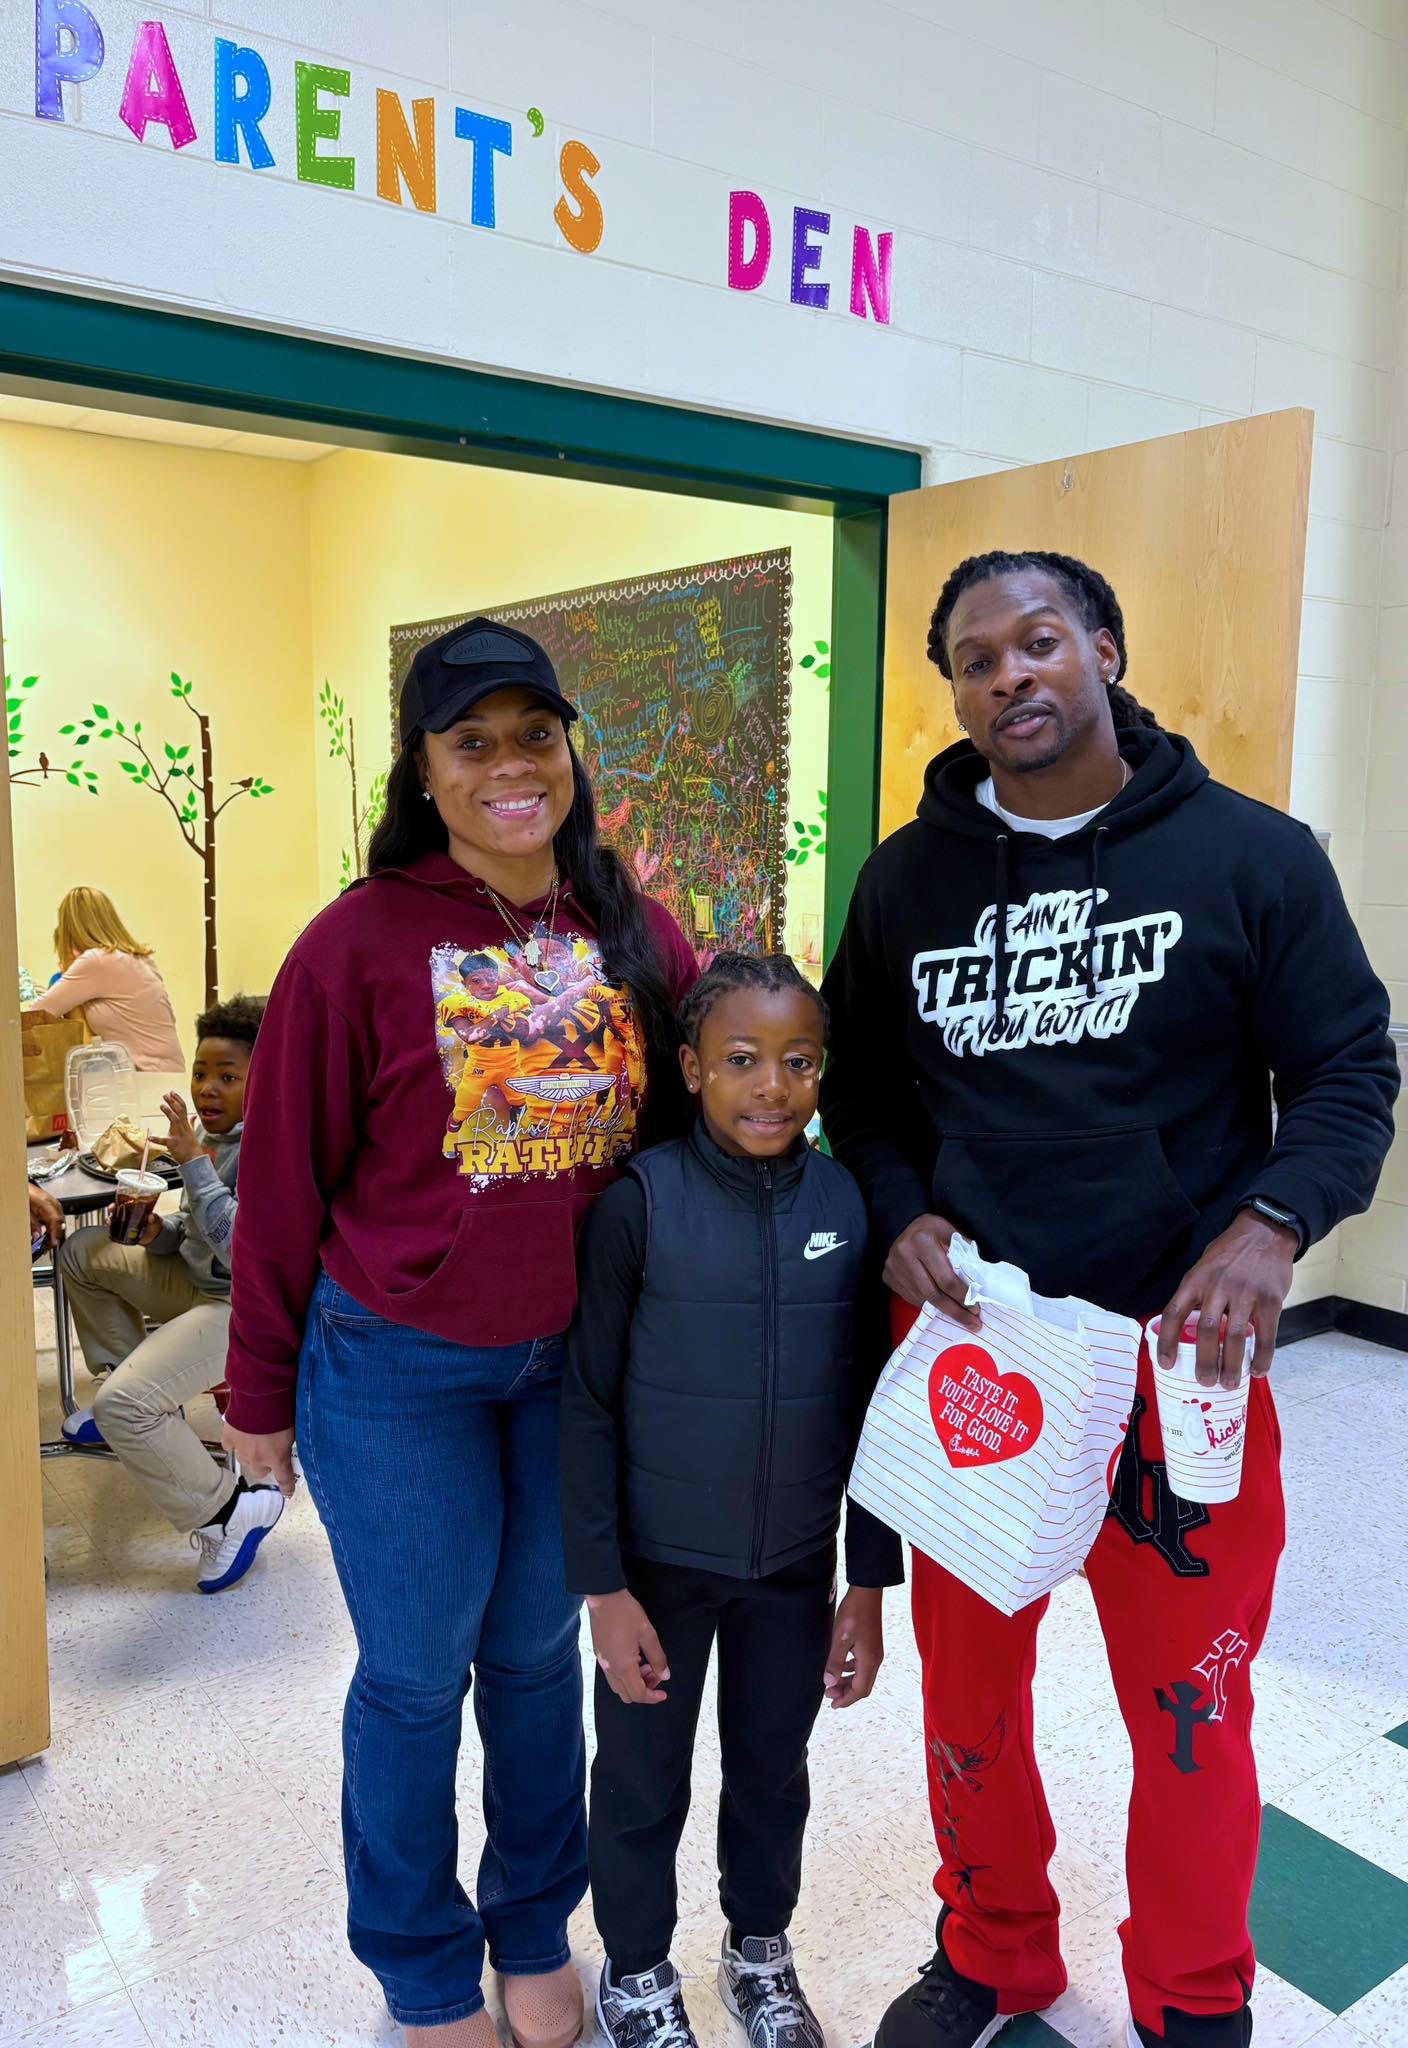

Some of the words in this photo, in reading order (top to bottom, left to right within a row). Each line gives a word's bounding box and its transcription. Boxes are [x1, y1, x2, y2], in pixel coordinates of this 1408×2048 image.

[35, 0, 604, 255] PARENT'S
[727, 189, 895, 325] DEN
[1012, 893, 1106, 940] AIN'T
[917, 920, 1073, 1014] TRICKIN'
[948, 1015, 975, 1053] IF
[976, 1010, 1027, 1049] YOU
[1035, 1001, 1095, 1041] GOT
[467, 1103, 558, 1155] Raphael
[809, 1231, 838, 1248] NIKE
[938, 1374, 979, 1413] YOU'LL
[977, 1400, 1013, 1434] LOVE
[1010, 1419, 1029, 1442] IT
[961, 1365, 1004, 1404] TASTE
[1000, 1390, 1019, 1415] IT.
[939, 1401, 968, 1431] FOR
[966, 1418, 1002, 1454] GOOD.
